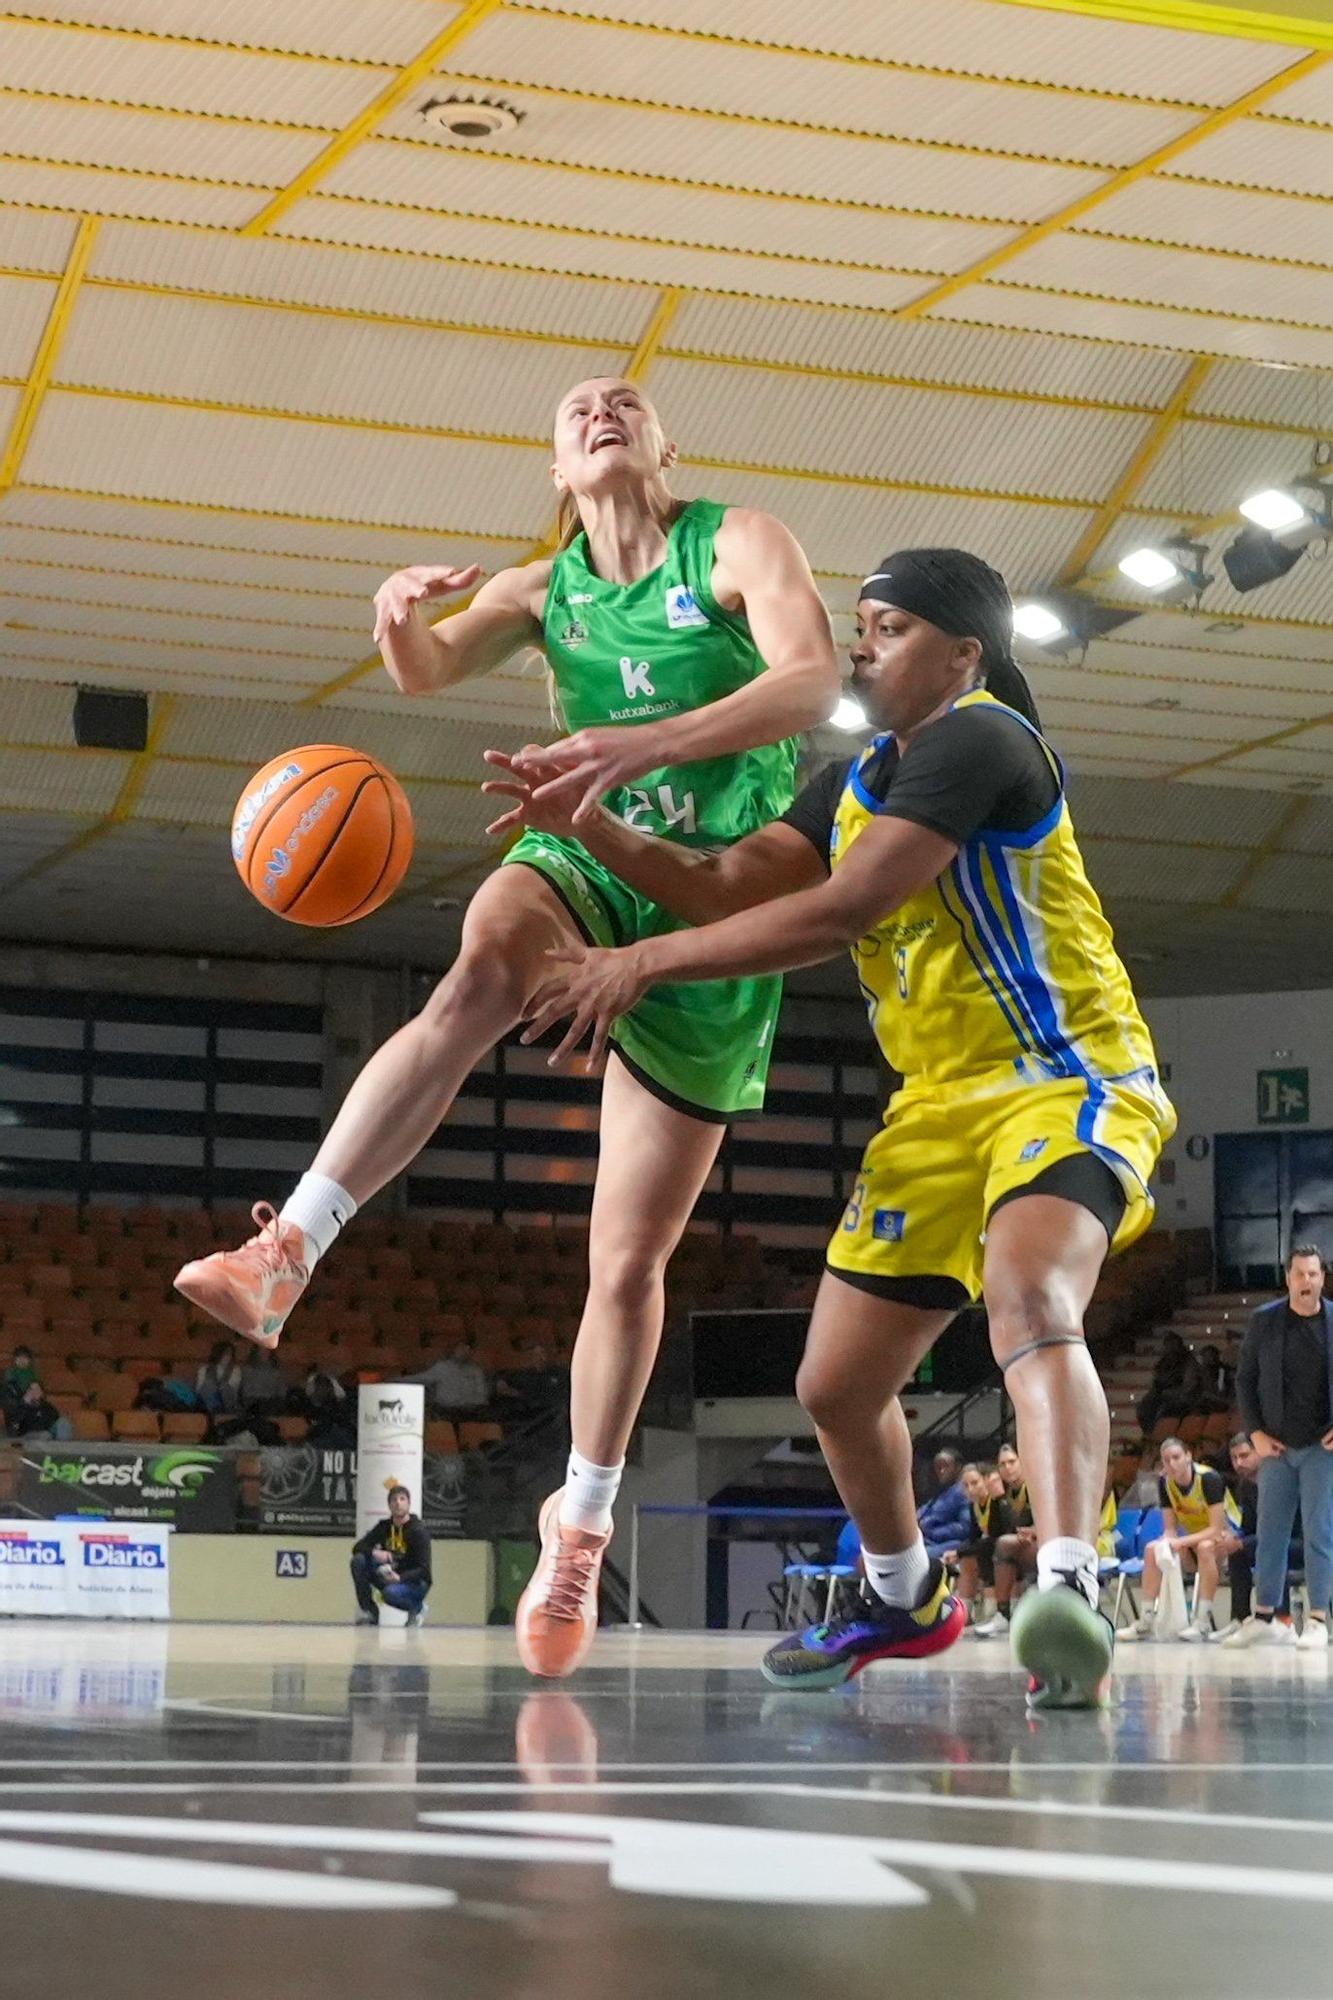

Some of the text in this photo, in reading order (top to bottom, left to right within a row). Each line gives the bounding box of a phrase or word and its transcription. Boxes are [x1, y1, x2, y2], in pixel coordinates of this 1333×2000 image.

[609, 699, 680, 721] kutxabank
[623, 784, 697, 834] 24
[40, 1455, 144, 1487] baicast
[323, 1450, 344, 1474] NO
[89, 1543, 158, 1567] Diario
[278, 1552, 306, 1576] A3
